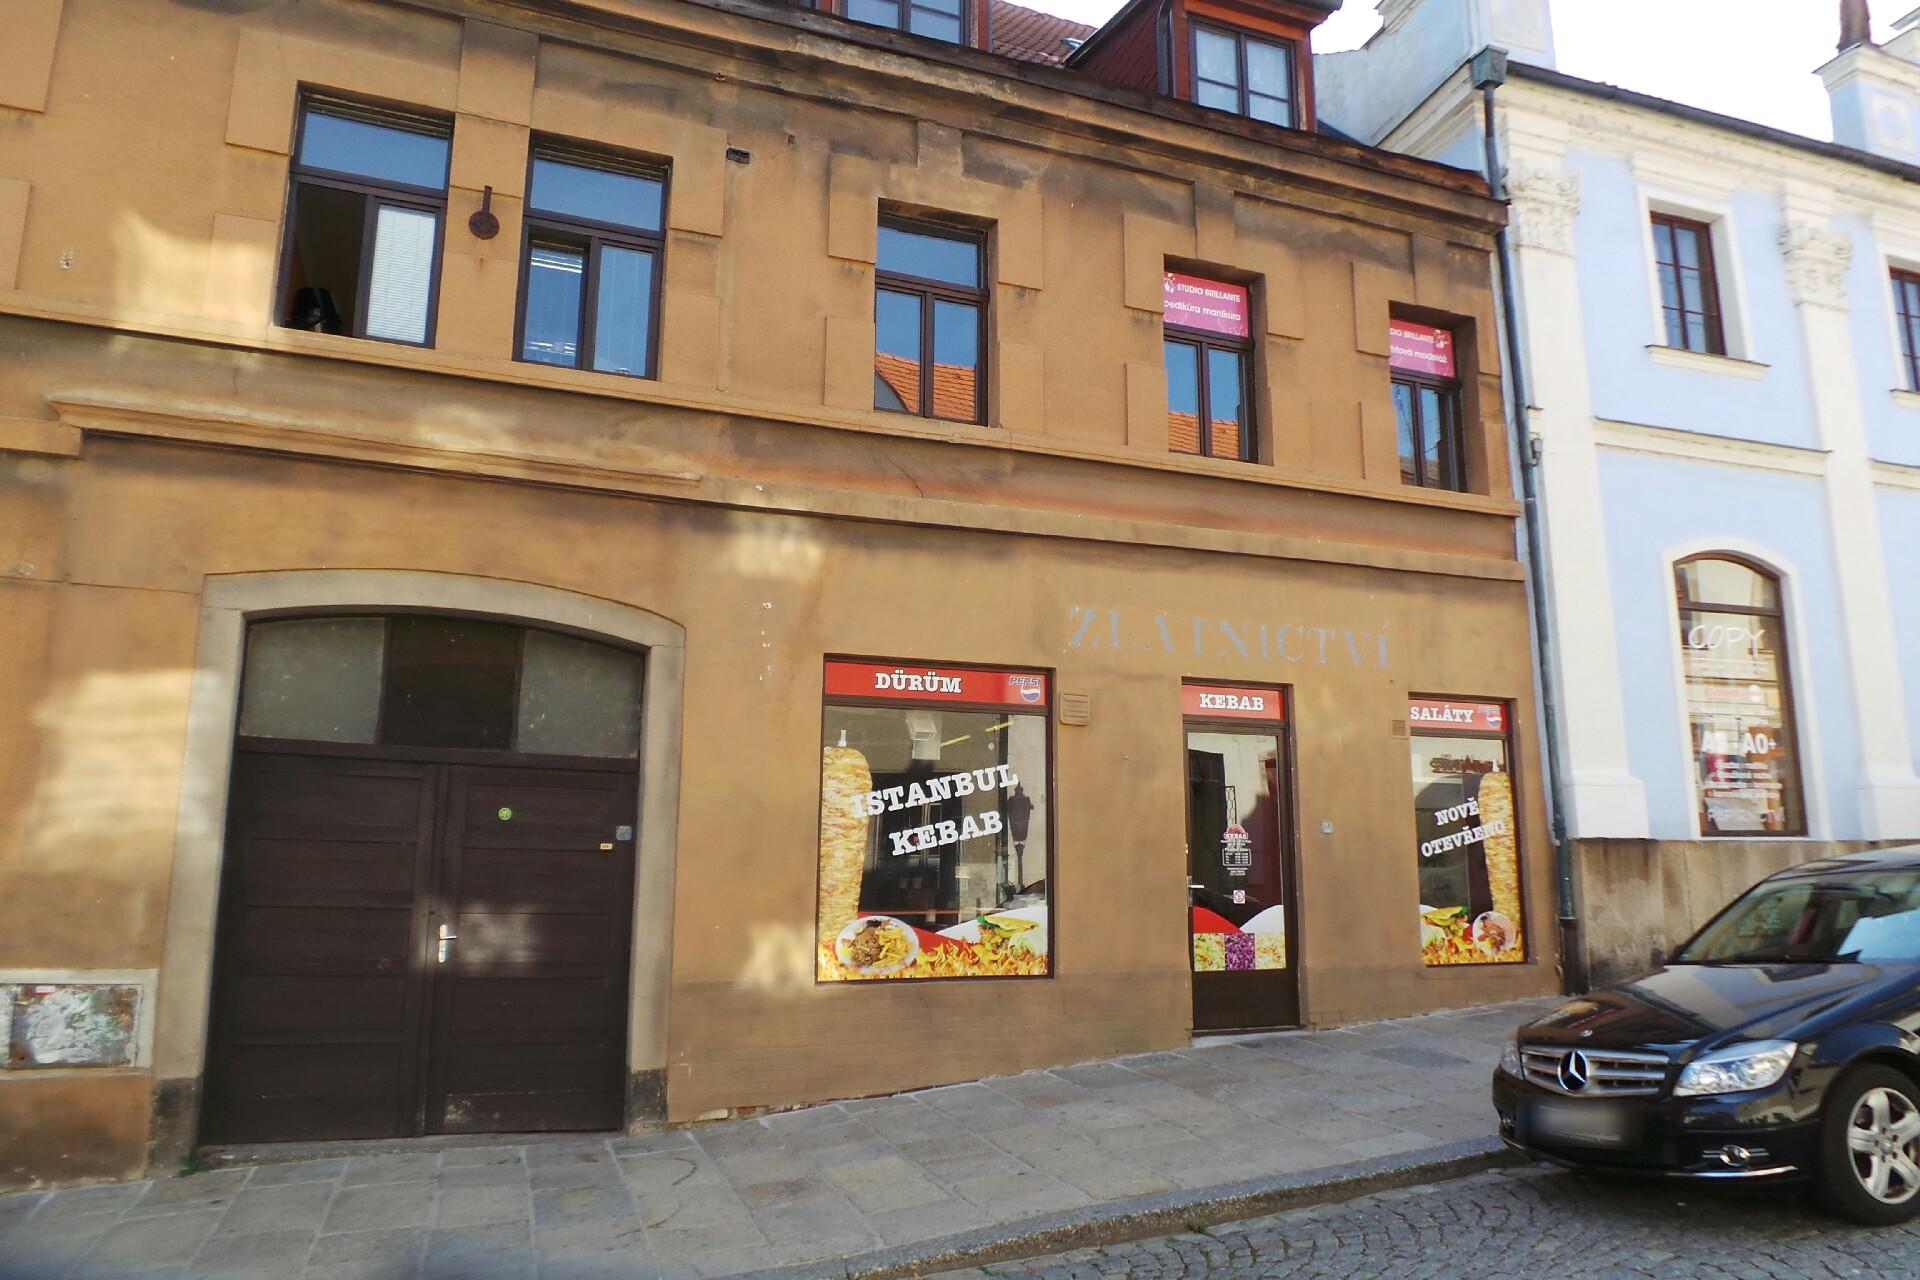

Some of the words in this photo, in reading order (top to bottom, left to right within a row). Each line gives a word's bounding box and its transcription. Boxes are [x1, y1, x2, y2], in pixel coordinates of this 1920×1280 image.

[1177, 283, 1204, 295] STUDIO
[1204, 288, 1241, 303] BRILLANTE
[1688, 624, 1766, 658] COPY
[875, 669, 962, 694] DÜRÜM
[1008, 675, 1041, 686] PEPSI
[1199, 693, 1265, 712] KEBAB
[1410, 704, 1474, 723] SALÁTY
[852, 764, 1019, 819] ISTANBUL
[1434, 797, 1480, 826] NOVĚ
[888, 810, 1003, 856] KEBAB
[1421, 820, 1505, 858] OTEVŘENO
